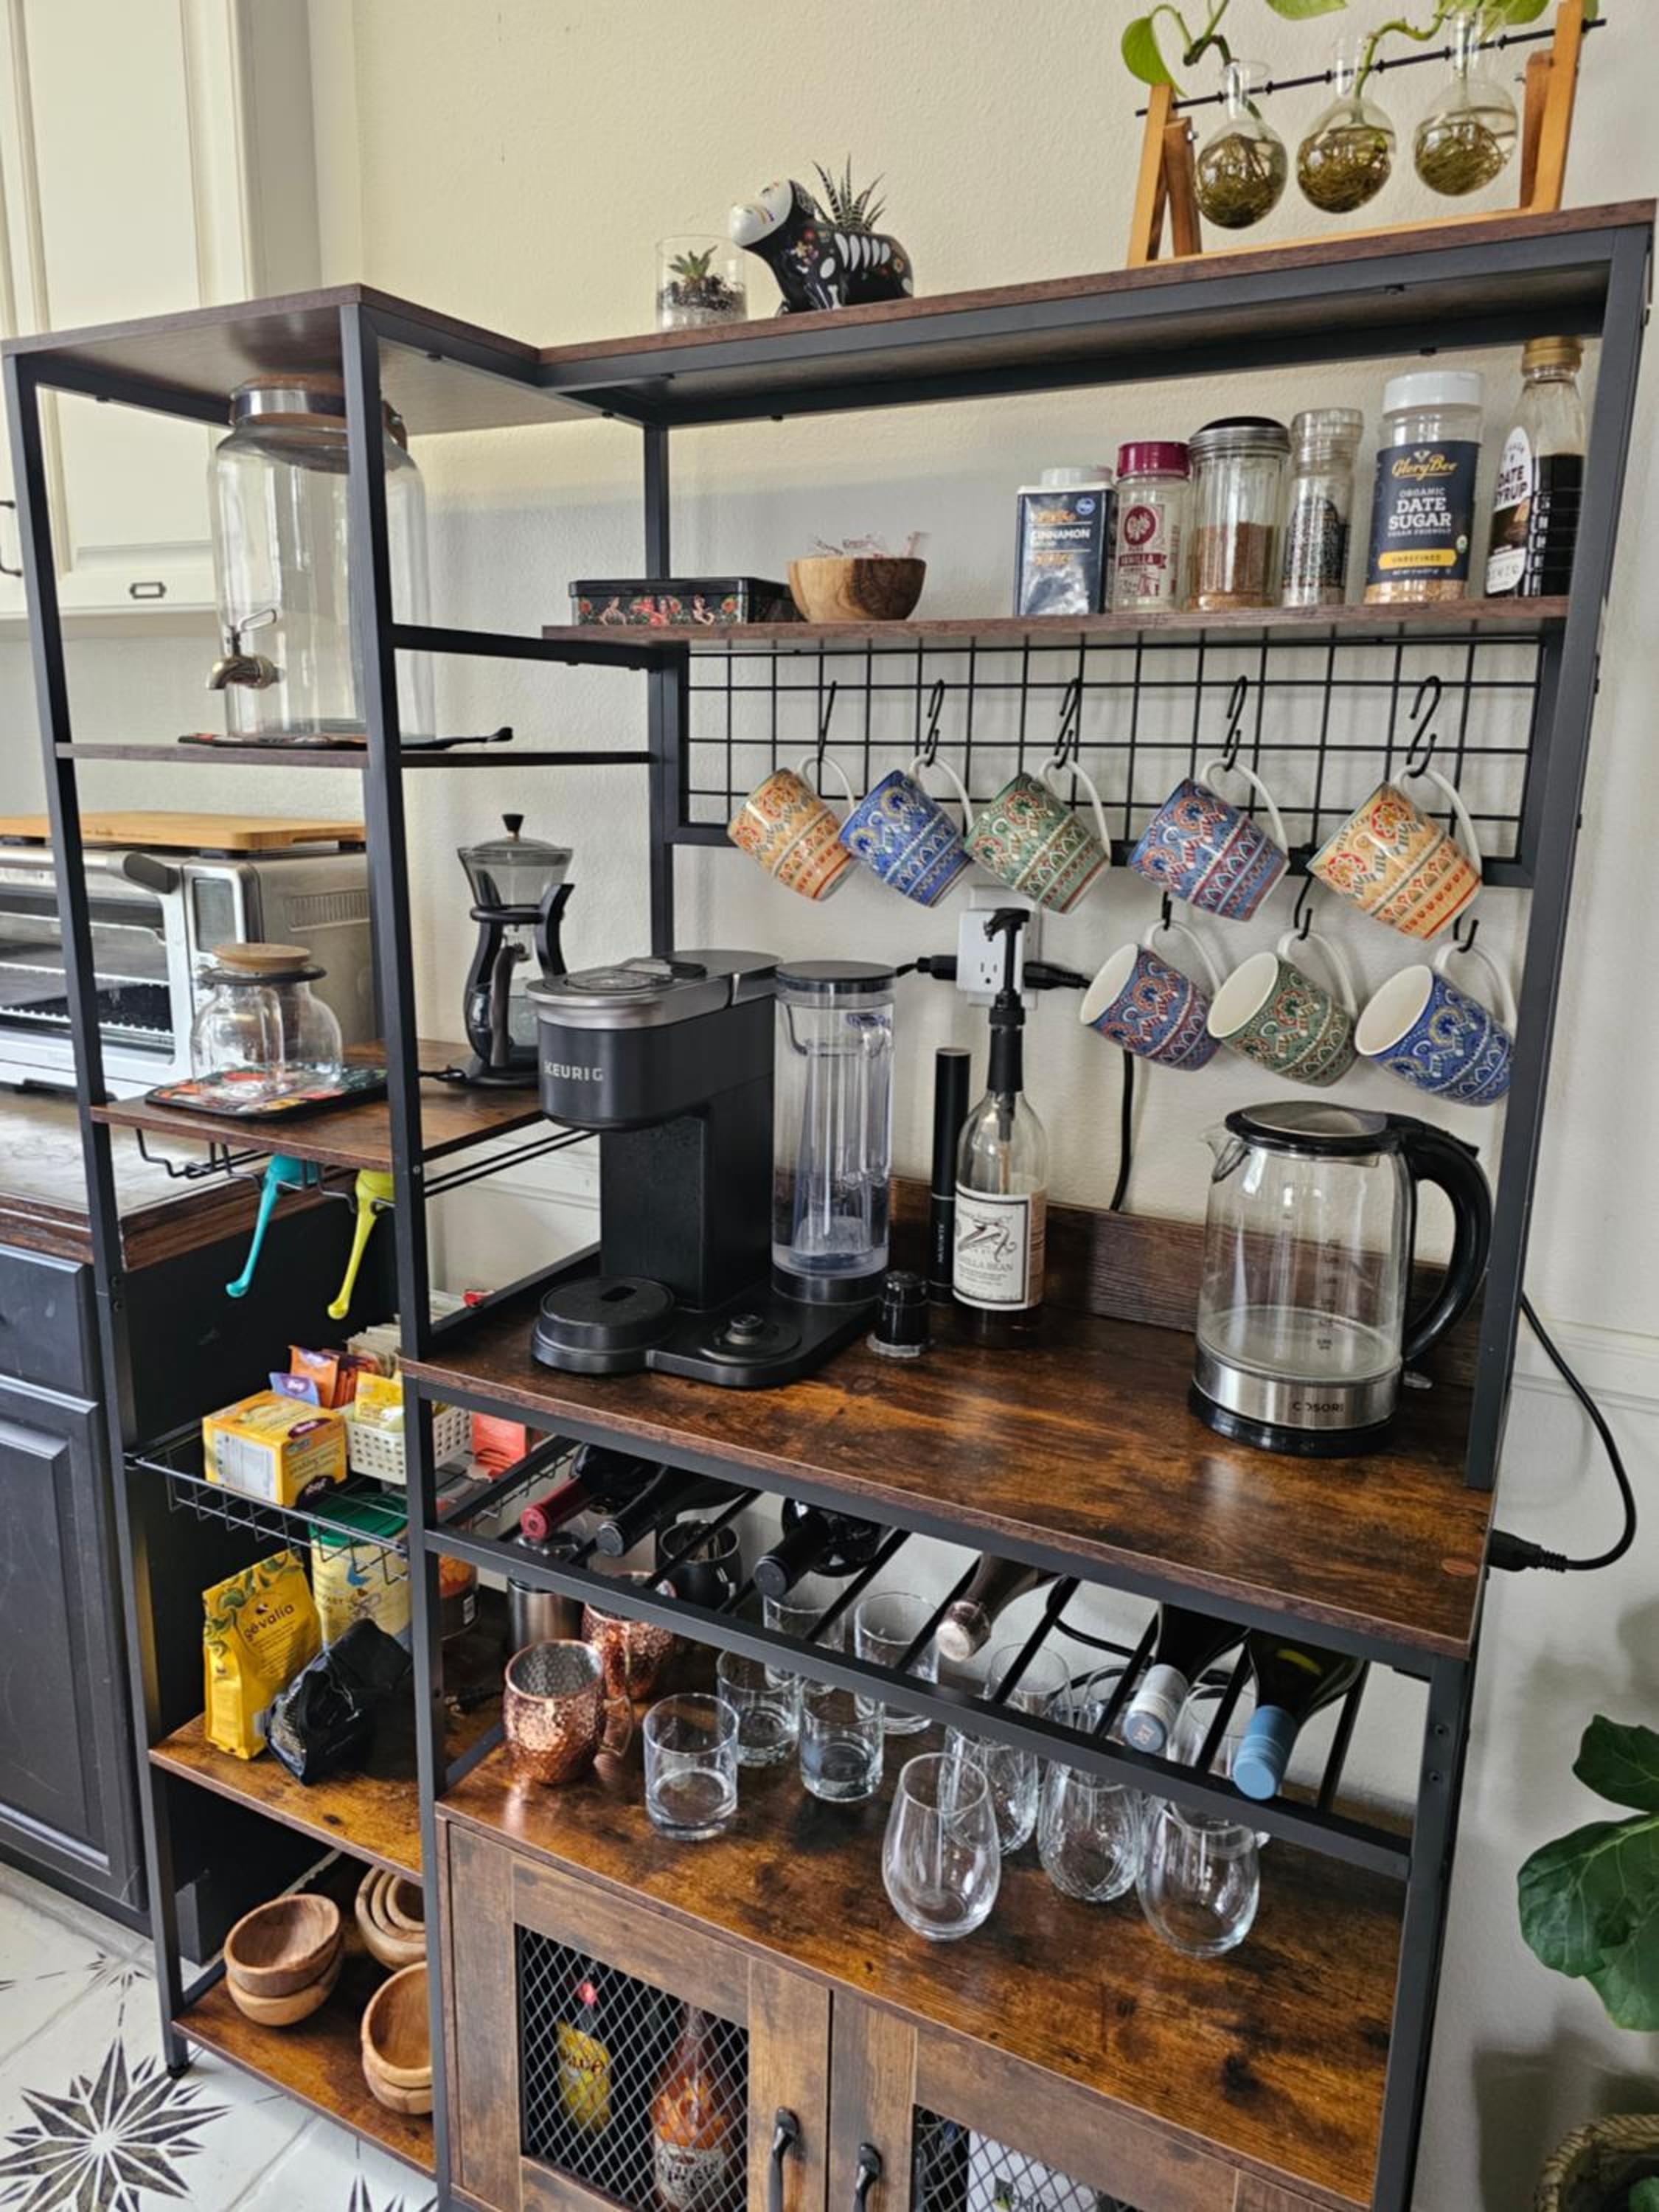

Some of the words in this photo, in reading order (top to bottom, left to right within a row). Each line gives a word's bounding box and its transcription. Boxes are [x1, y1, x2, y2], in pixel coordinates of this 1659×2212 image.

[1399, 487, 1446, 498] ORGANIC
[1396, 497, 1447, 514] DATE
[1388, 512, 1452, 530] SUGAR
[543, 1060, 604, 1082] KEURIG
[244, 1604, 294, 1642] gevalia
